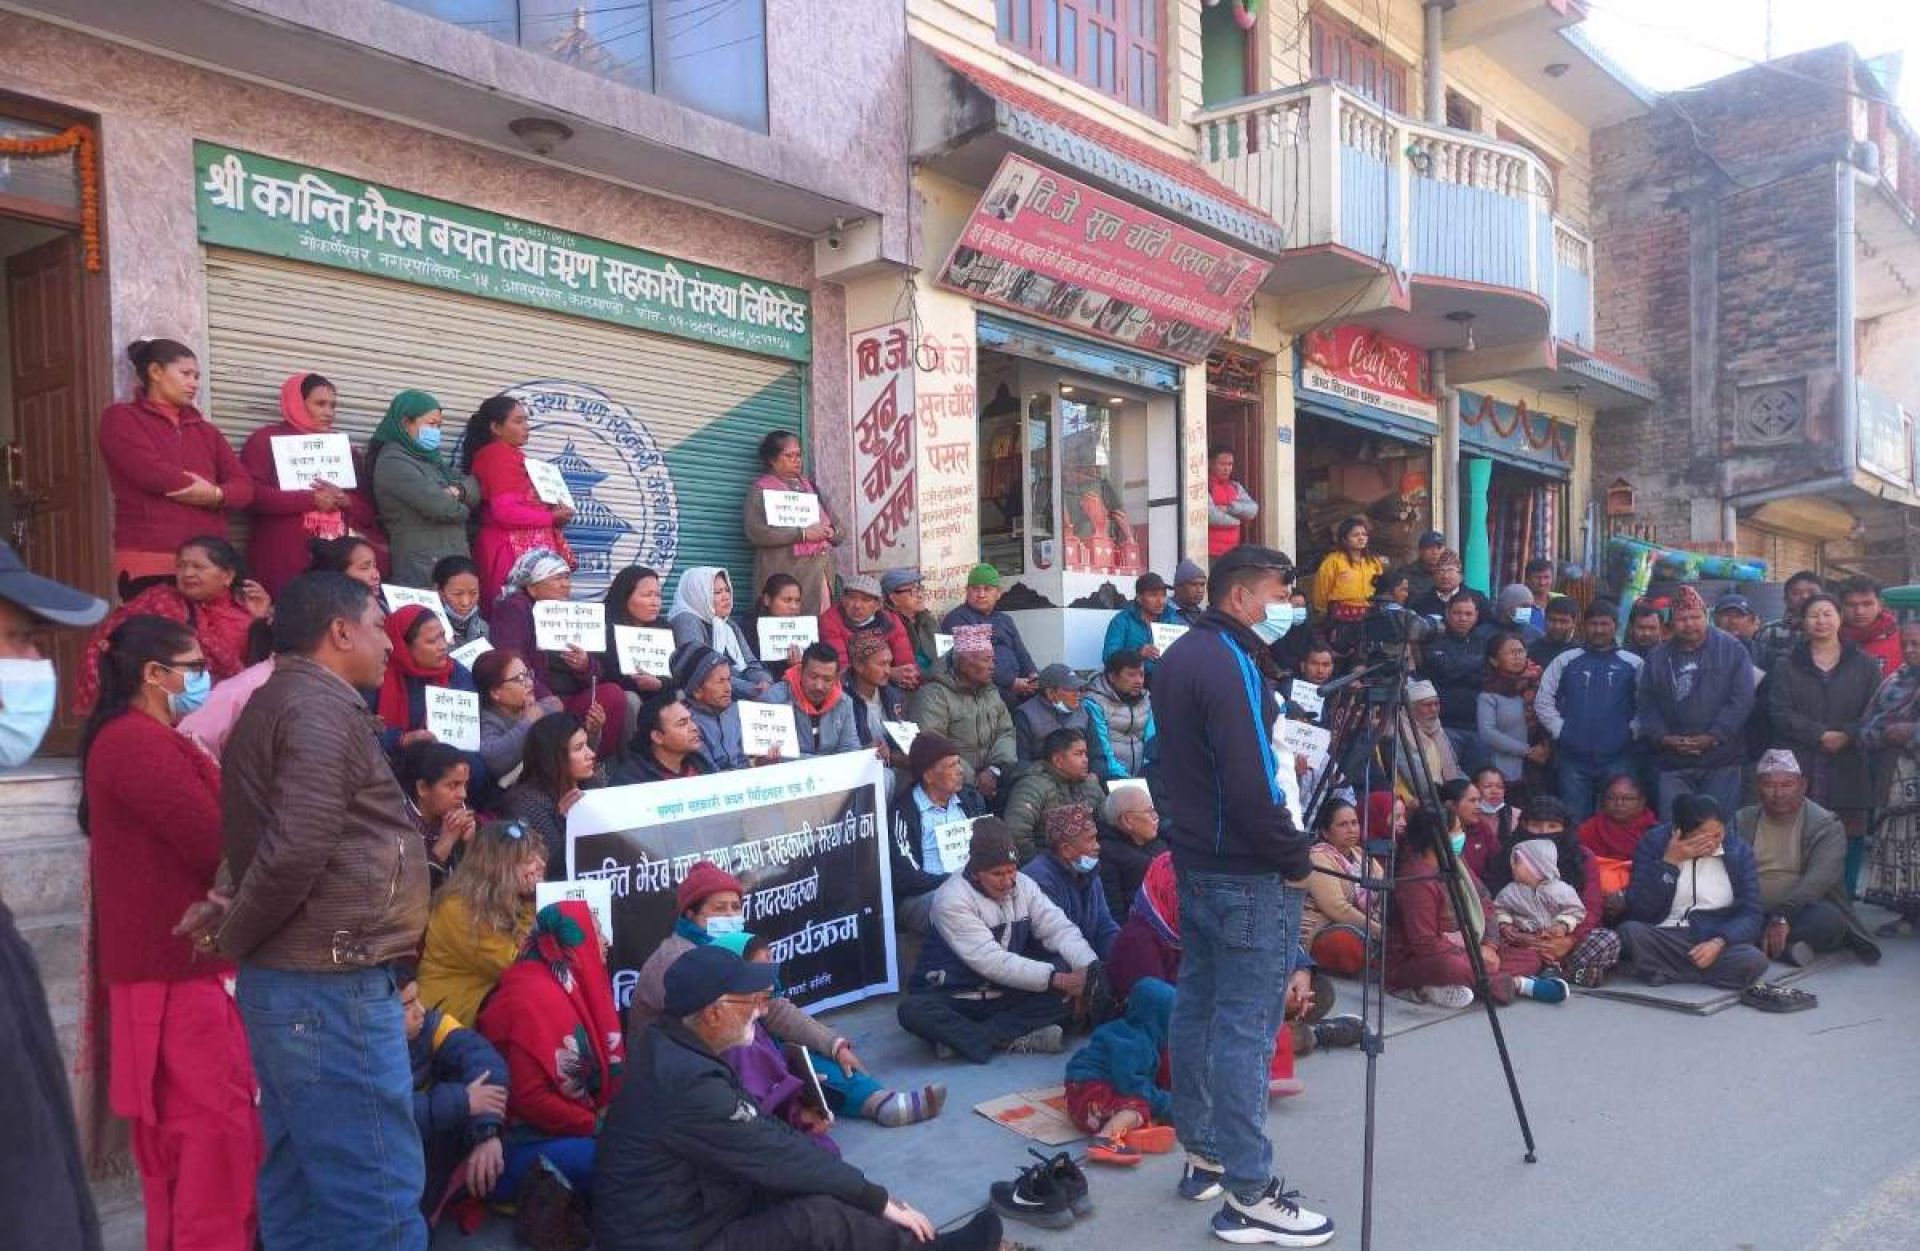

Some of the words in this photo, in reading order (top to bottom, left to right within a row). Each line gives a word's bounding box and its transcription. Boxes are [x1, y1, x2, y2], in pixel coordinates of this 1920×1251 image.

[204, 155, 245, 212] श्री
[251, 173, 353, 235] कान्ति
[357, 186, 424, 251] भैरब
[429, 215, 496, 266] बचत
[498, 232, 548, 278] तथा
[549, 245, 600, 289] ऋण
[602, 256, 685, 308] सहकारी
[686, 271, 739, 321] संस्था
[739, 280, 807, 334] लिमिटेड
[860, 467, 915, 562] पसल
